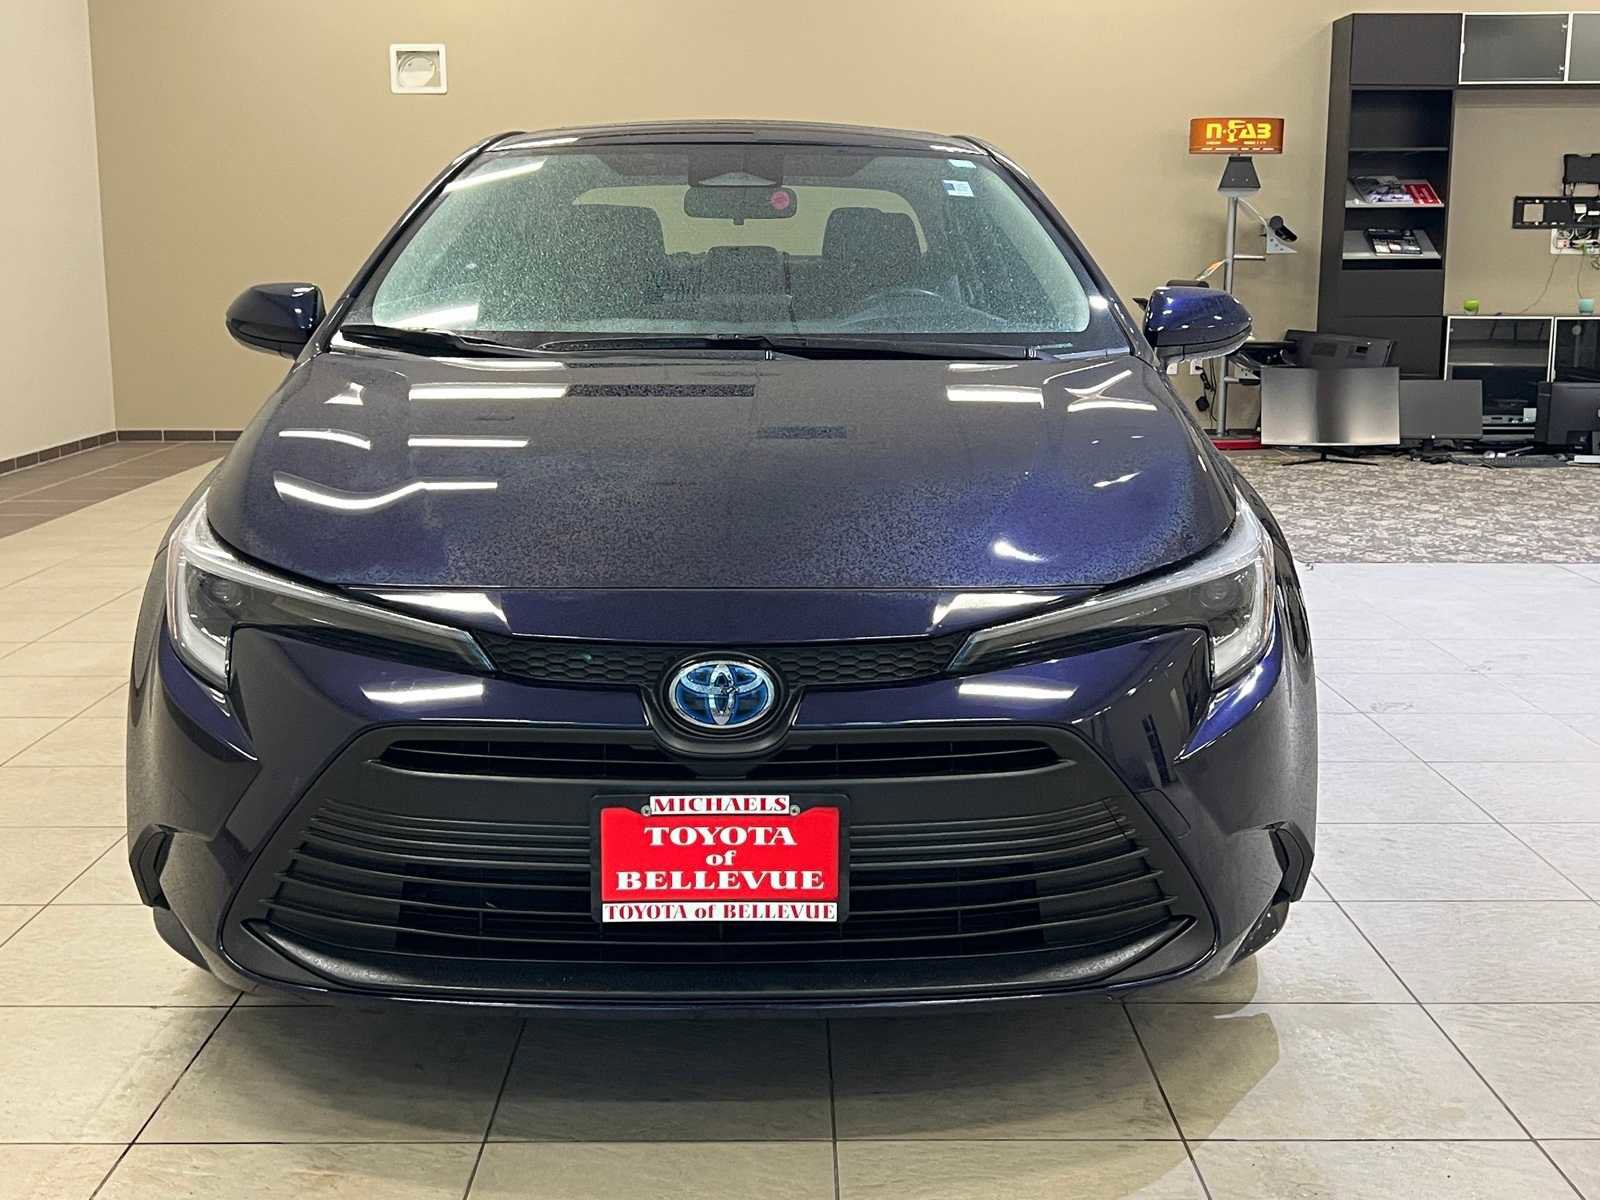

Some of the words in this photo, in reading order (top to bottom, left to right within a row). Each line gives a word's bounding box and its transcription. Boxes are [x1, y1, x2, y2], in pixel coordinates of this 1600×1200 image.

[653, 797, 787, 812] MICHAELS
[644, 826, 797, 846] TOYOTA
[705, 850, 736, 866] of
[616, 871, 824, 890] BELLEVUE
[605, 905, 687, 920] TOYOTA
[694, 905, 714, 919] of
[723, 904, 836, 920] BELLEVUE
